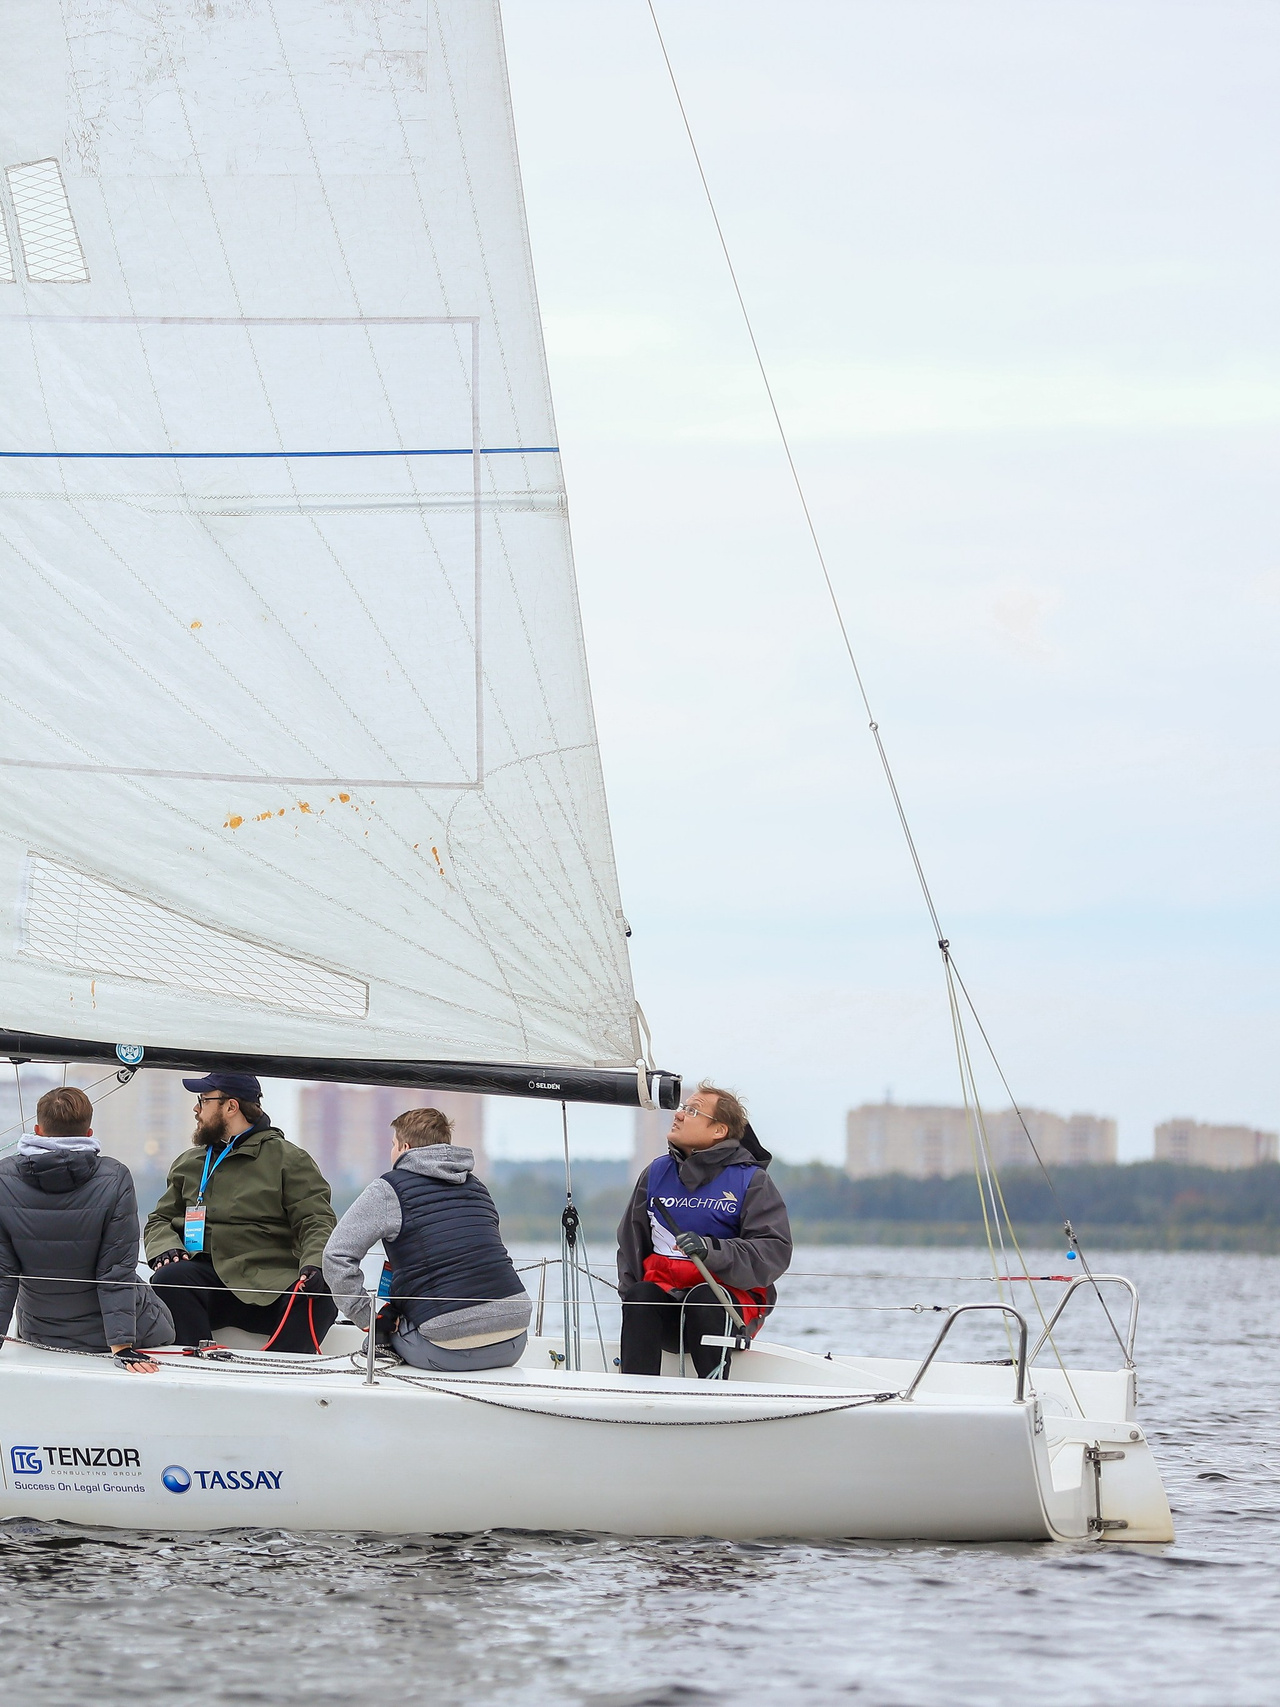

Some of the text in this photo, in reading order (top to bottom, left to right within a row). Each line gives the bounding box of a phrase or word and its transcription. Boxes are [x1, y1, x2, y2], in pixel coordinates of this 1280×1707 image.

[43, 1446, 141, 1467] TENZOR
[14, 1481, 146, 1493] Success On Legal Grounds
[194, 1470, 283, 1490] TASSAY
